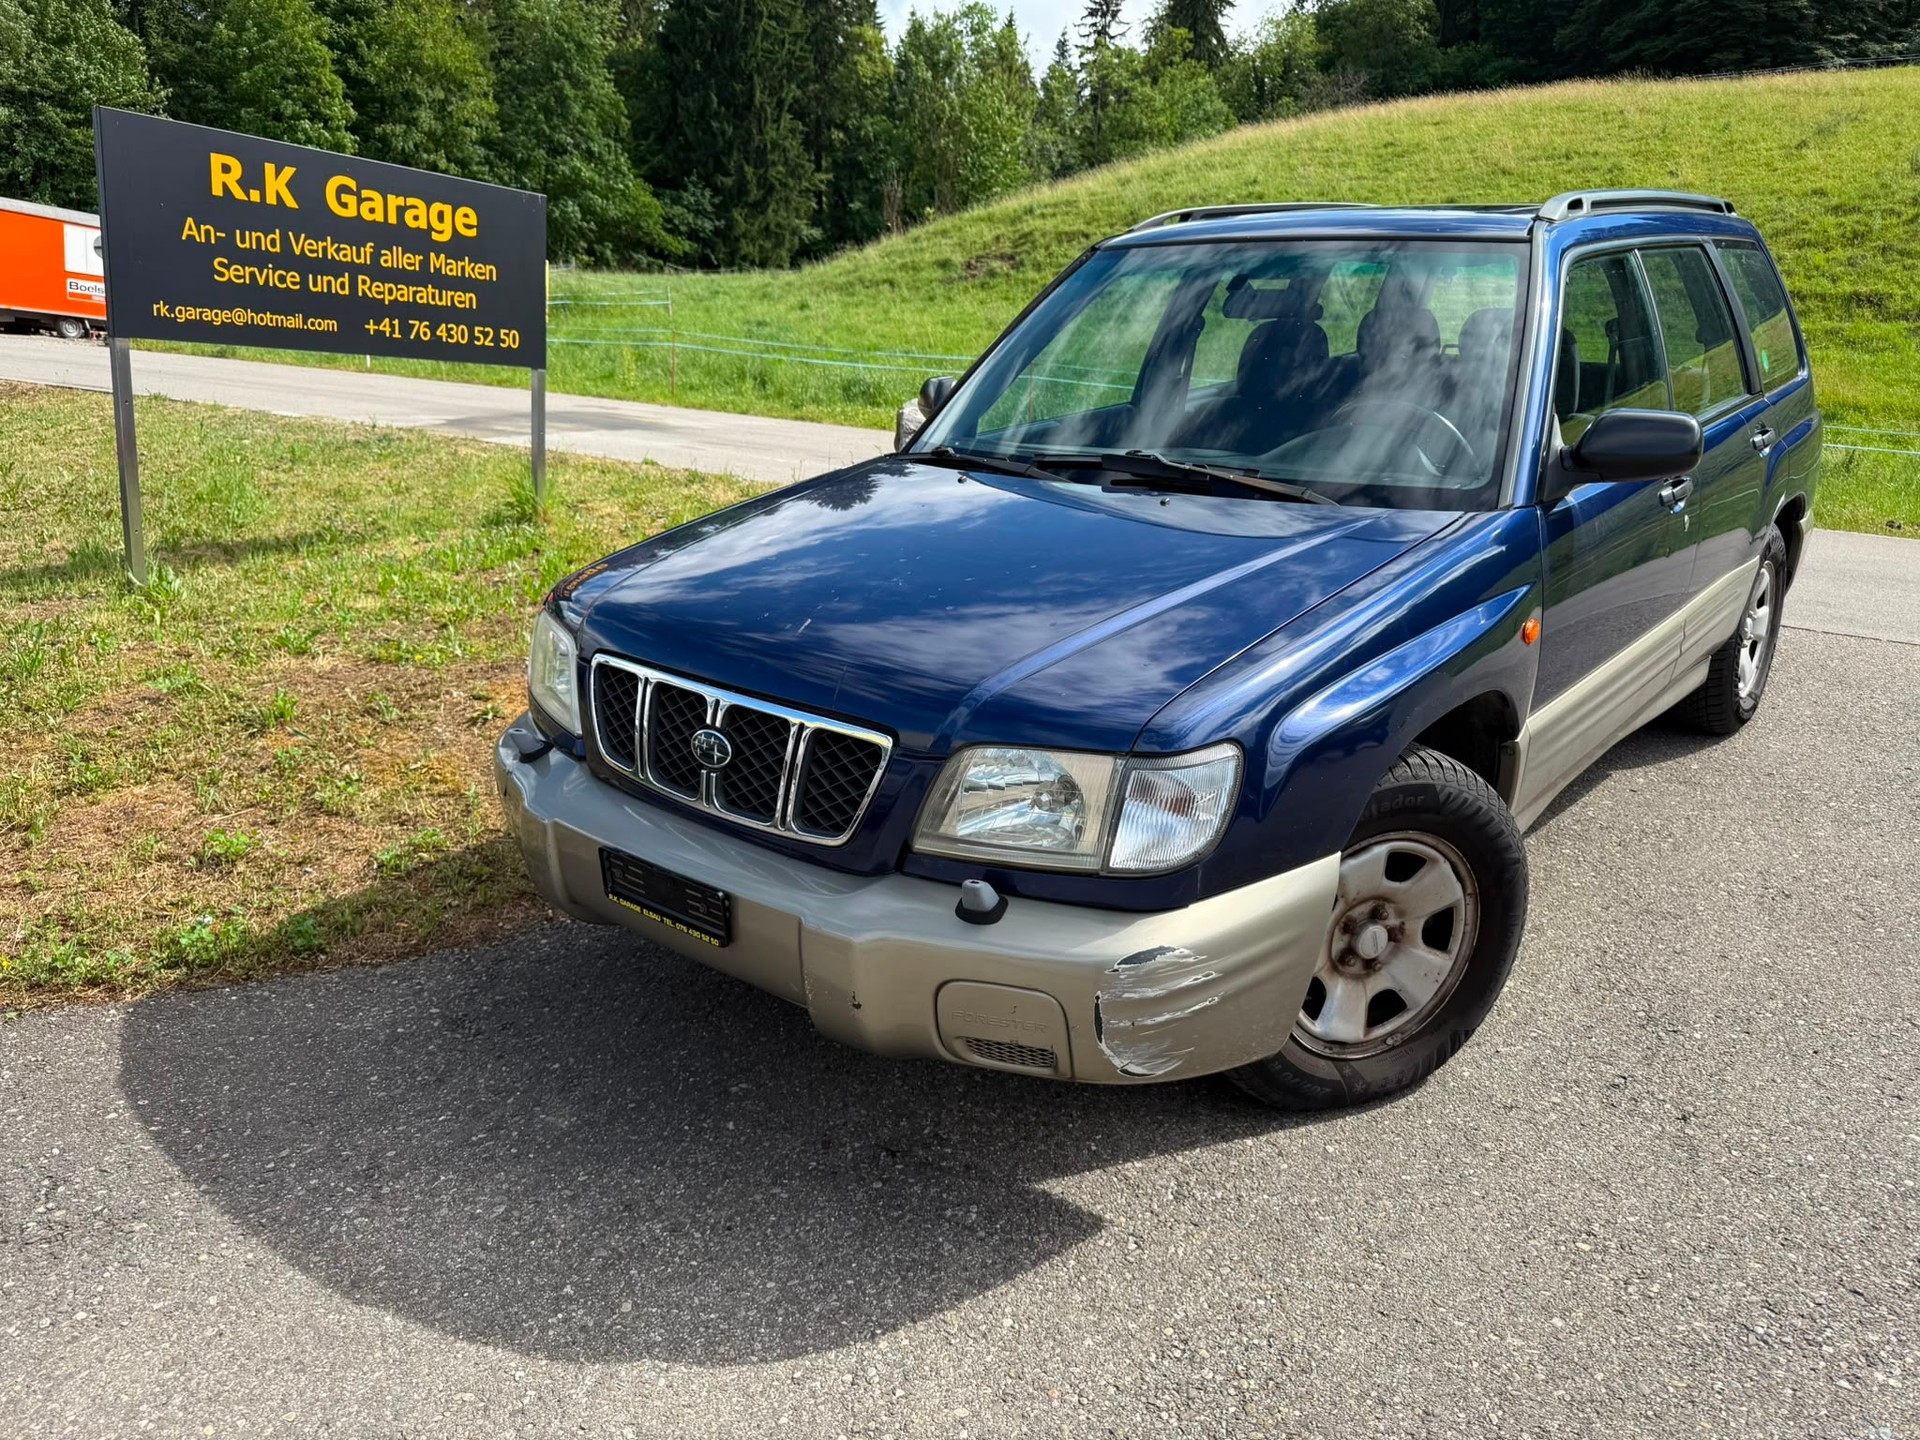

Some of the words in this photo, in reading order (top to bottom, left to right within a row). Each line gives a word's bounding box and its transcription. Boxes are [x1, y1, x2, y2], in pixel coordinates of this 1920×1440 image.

[209, 152, 299, 209] R.K
[325, 174, 478, 243] Garage
[181, 217, 226, 245] An-
[235, 229, 281, 253] und
[288, 232, 373, 266] Verkauf
[380, 246, 423, 271] aller
[429, 252, 497, 281] Marken
[69, 281, 104, 294] Boels
[213, 256, 301, 290] Service
[308, 274, 350, 297] und
[357, 274, 477, 309] Reparaturen
[152, 301, 338, 332] rk.garage@hotmail.com
[364, 317, 402, 339] +41
[408, 320, 431, 341] 76
[435, 323, 469, 345] 430
[474, 326, 495, 347] 52
[499, 328, 520, 349] 50
[619, 898, 641, 914] GARAGE
[662, 916, 676, 928] TEL.
[675, 922, 688, 933] 076
[688, 928, 701, 939] 430
[701, 933, 710, 943] 52
[710, 937, 719, 946] 50
[951, 1010, 1048, 1033] FORESTER
